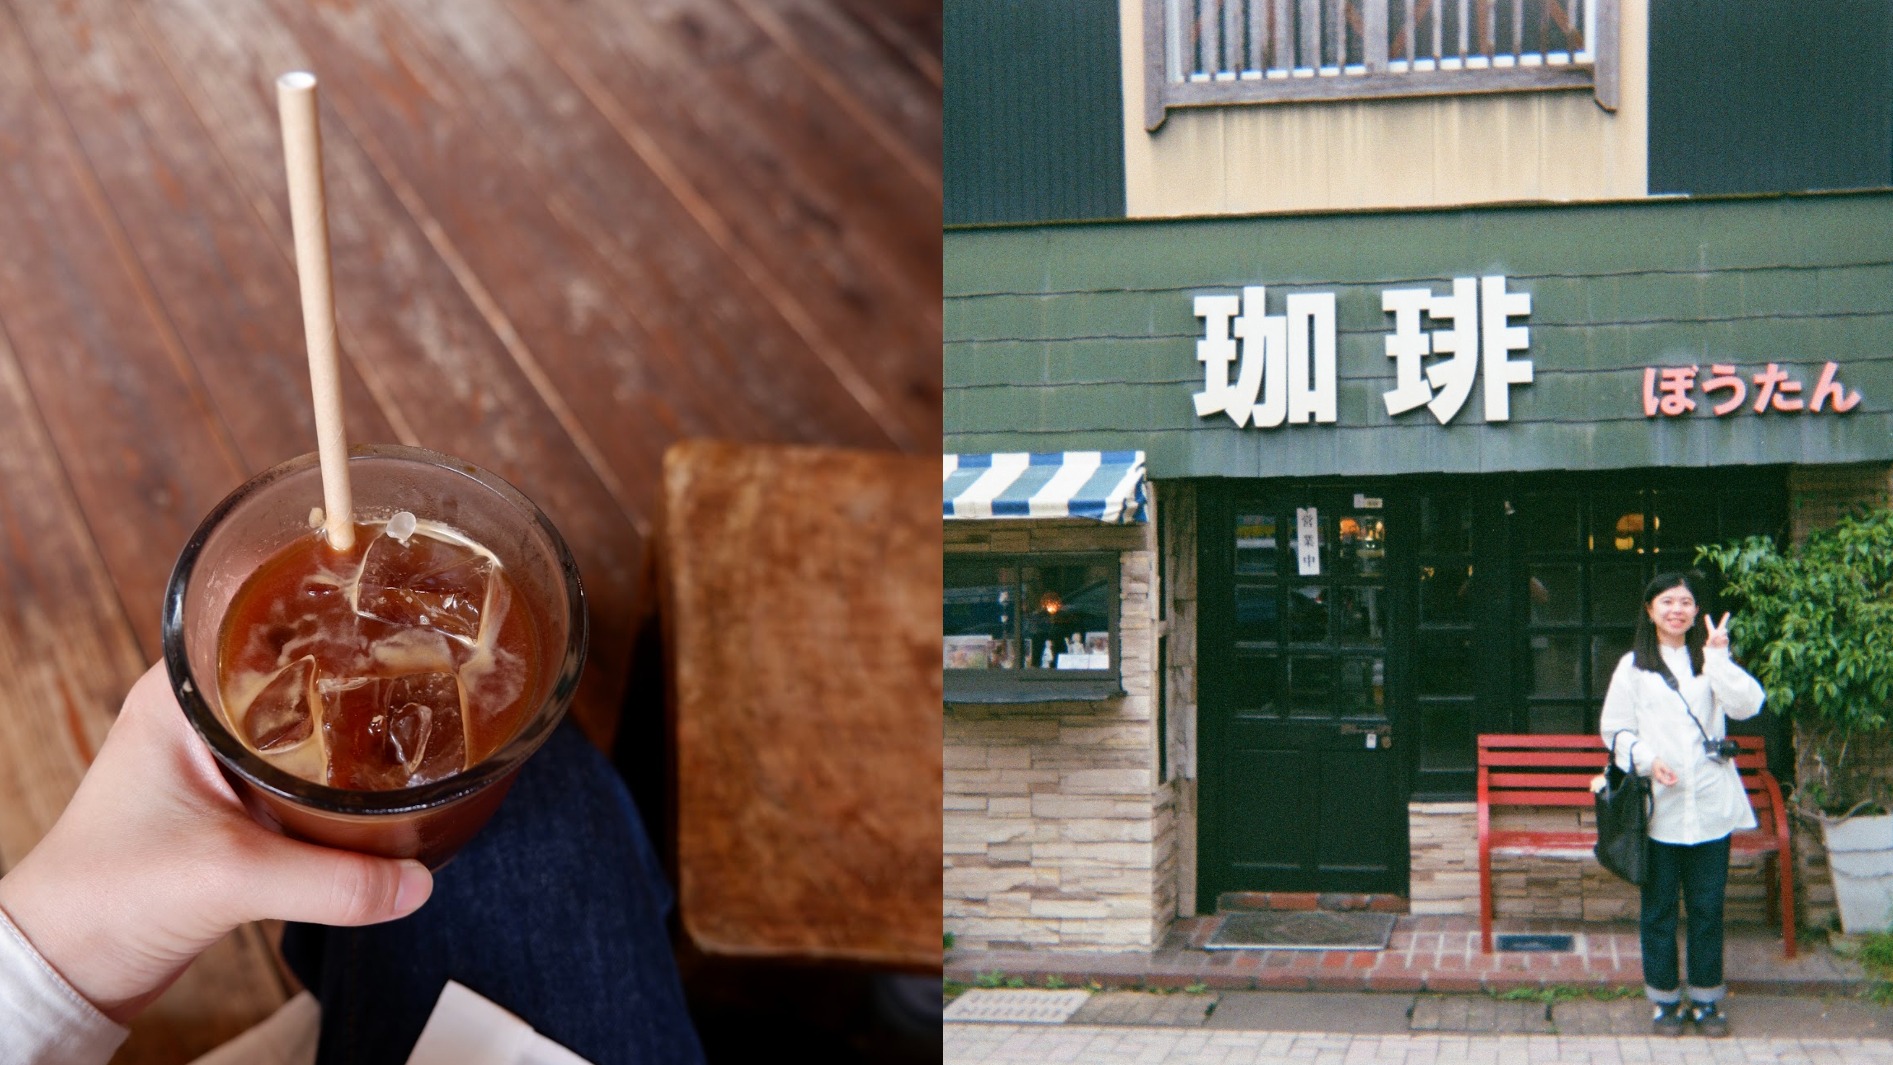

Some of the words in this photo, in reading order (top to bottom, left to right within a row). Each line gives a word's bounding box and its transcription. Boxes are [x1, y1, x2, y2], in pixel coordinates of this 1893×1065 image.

[1193, 276, 1533, 428] 珈琲
[1643, 361, 1861, 416] ぼうたん
[1302, 514, 1315, 567] 営業中
